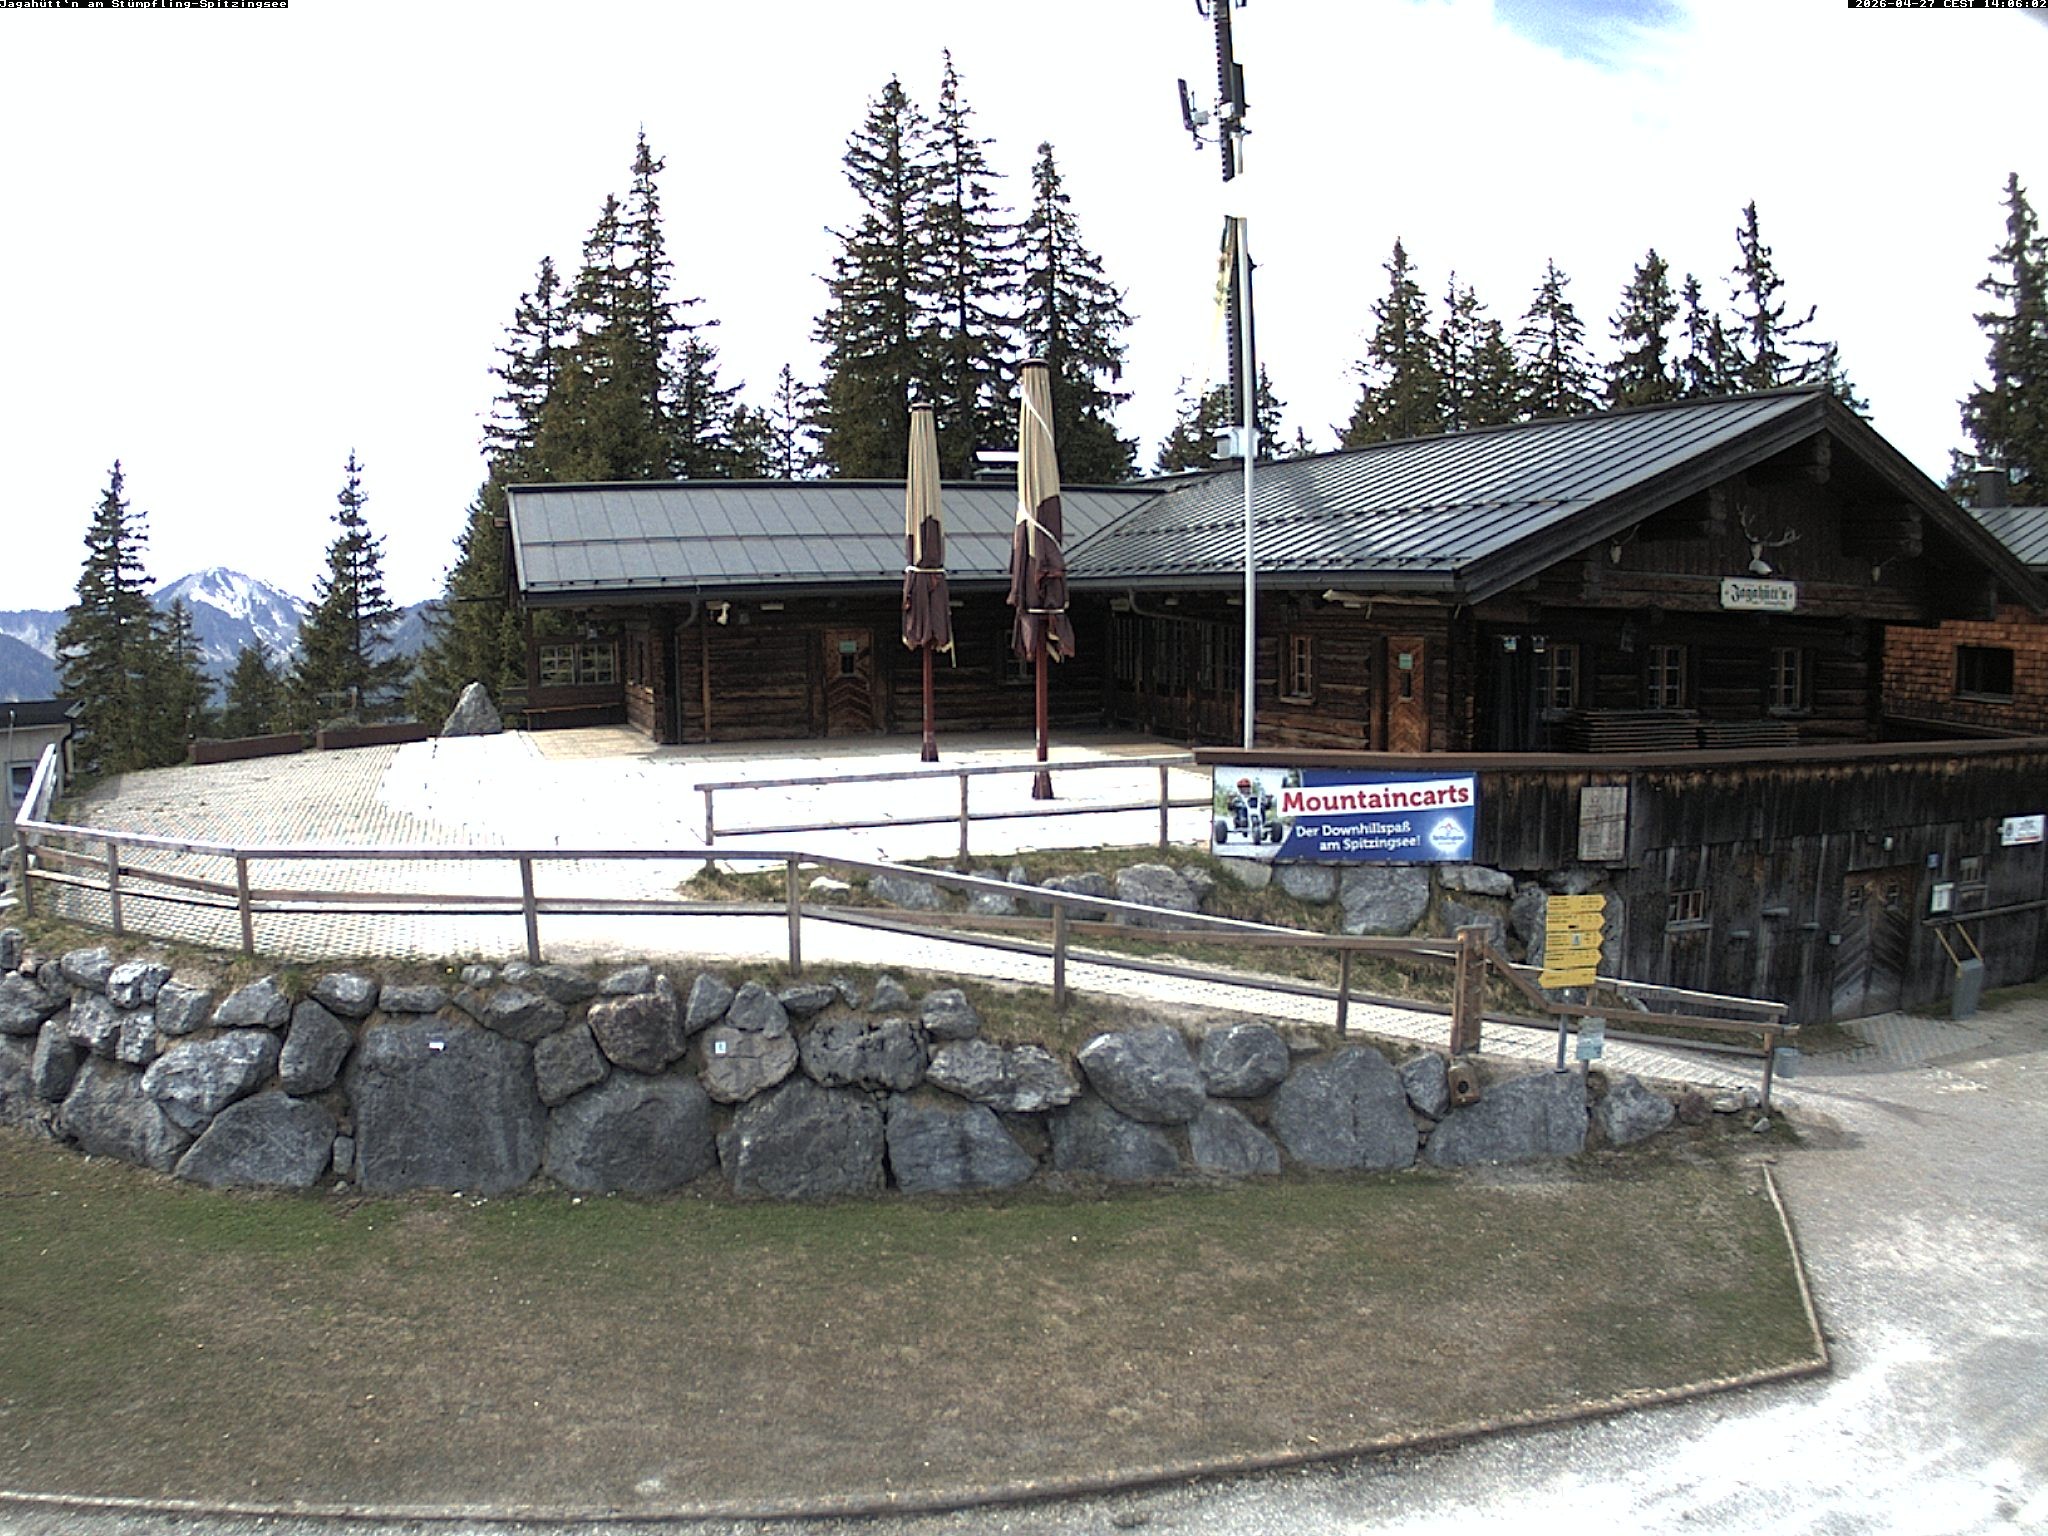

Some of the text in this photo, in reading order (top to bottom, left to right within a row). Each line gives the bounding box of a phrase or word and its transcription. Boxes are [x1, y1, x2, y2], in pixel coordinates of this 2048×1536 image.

[1282, 784, 1469, 813] Mountaincarts
[1295, 820, 1411, 838] Der Downhillspaß
[1319, 840, 1341, 852] am
[1342, 835, 1421, 852] Spitzingsee!
